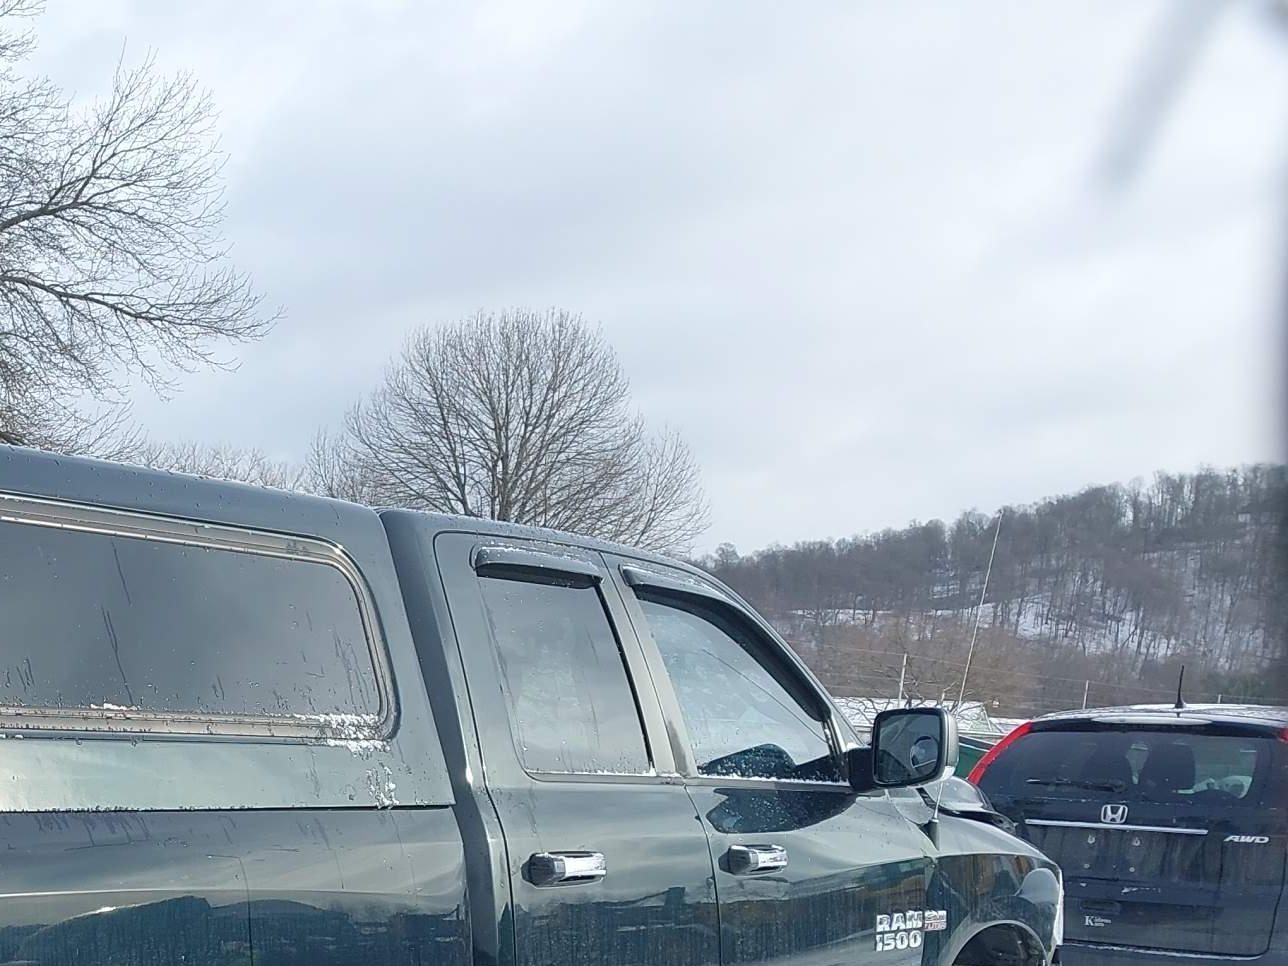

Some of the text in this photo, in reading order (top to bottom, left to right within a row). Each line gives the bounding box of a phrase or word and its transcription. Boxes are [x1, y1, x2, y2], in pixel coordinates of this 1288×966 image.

[1223, 835, 1270, 844] AWD
[876, 910, 923, 932] RAM
[876, 930, 922, 952] 1500
